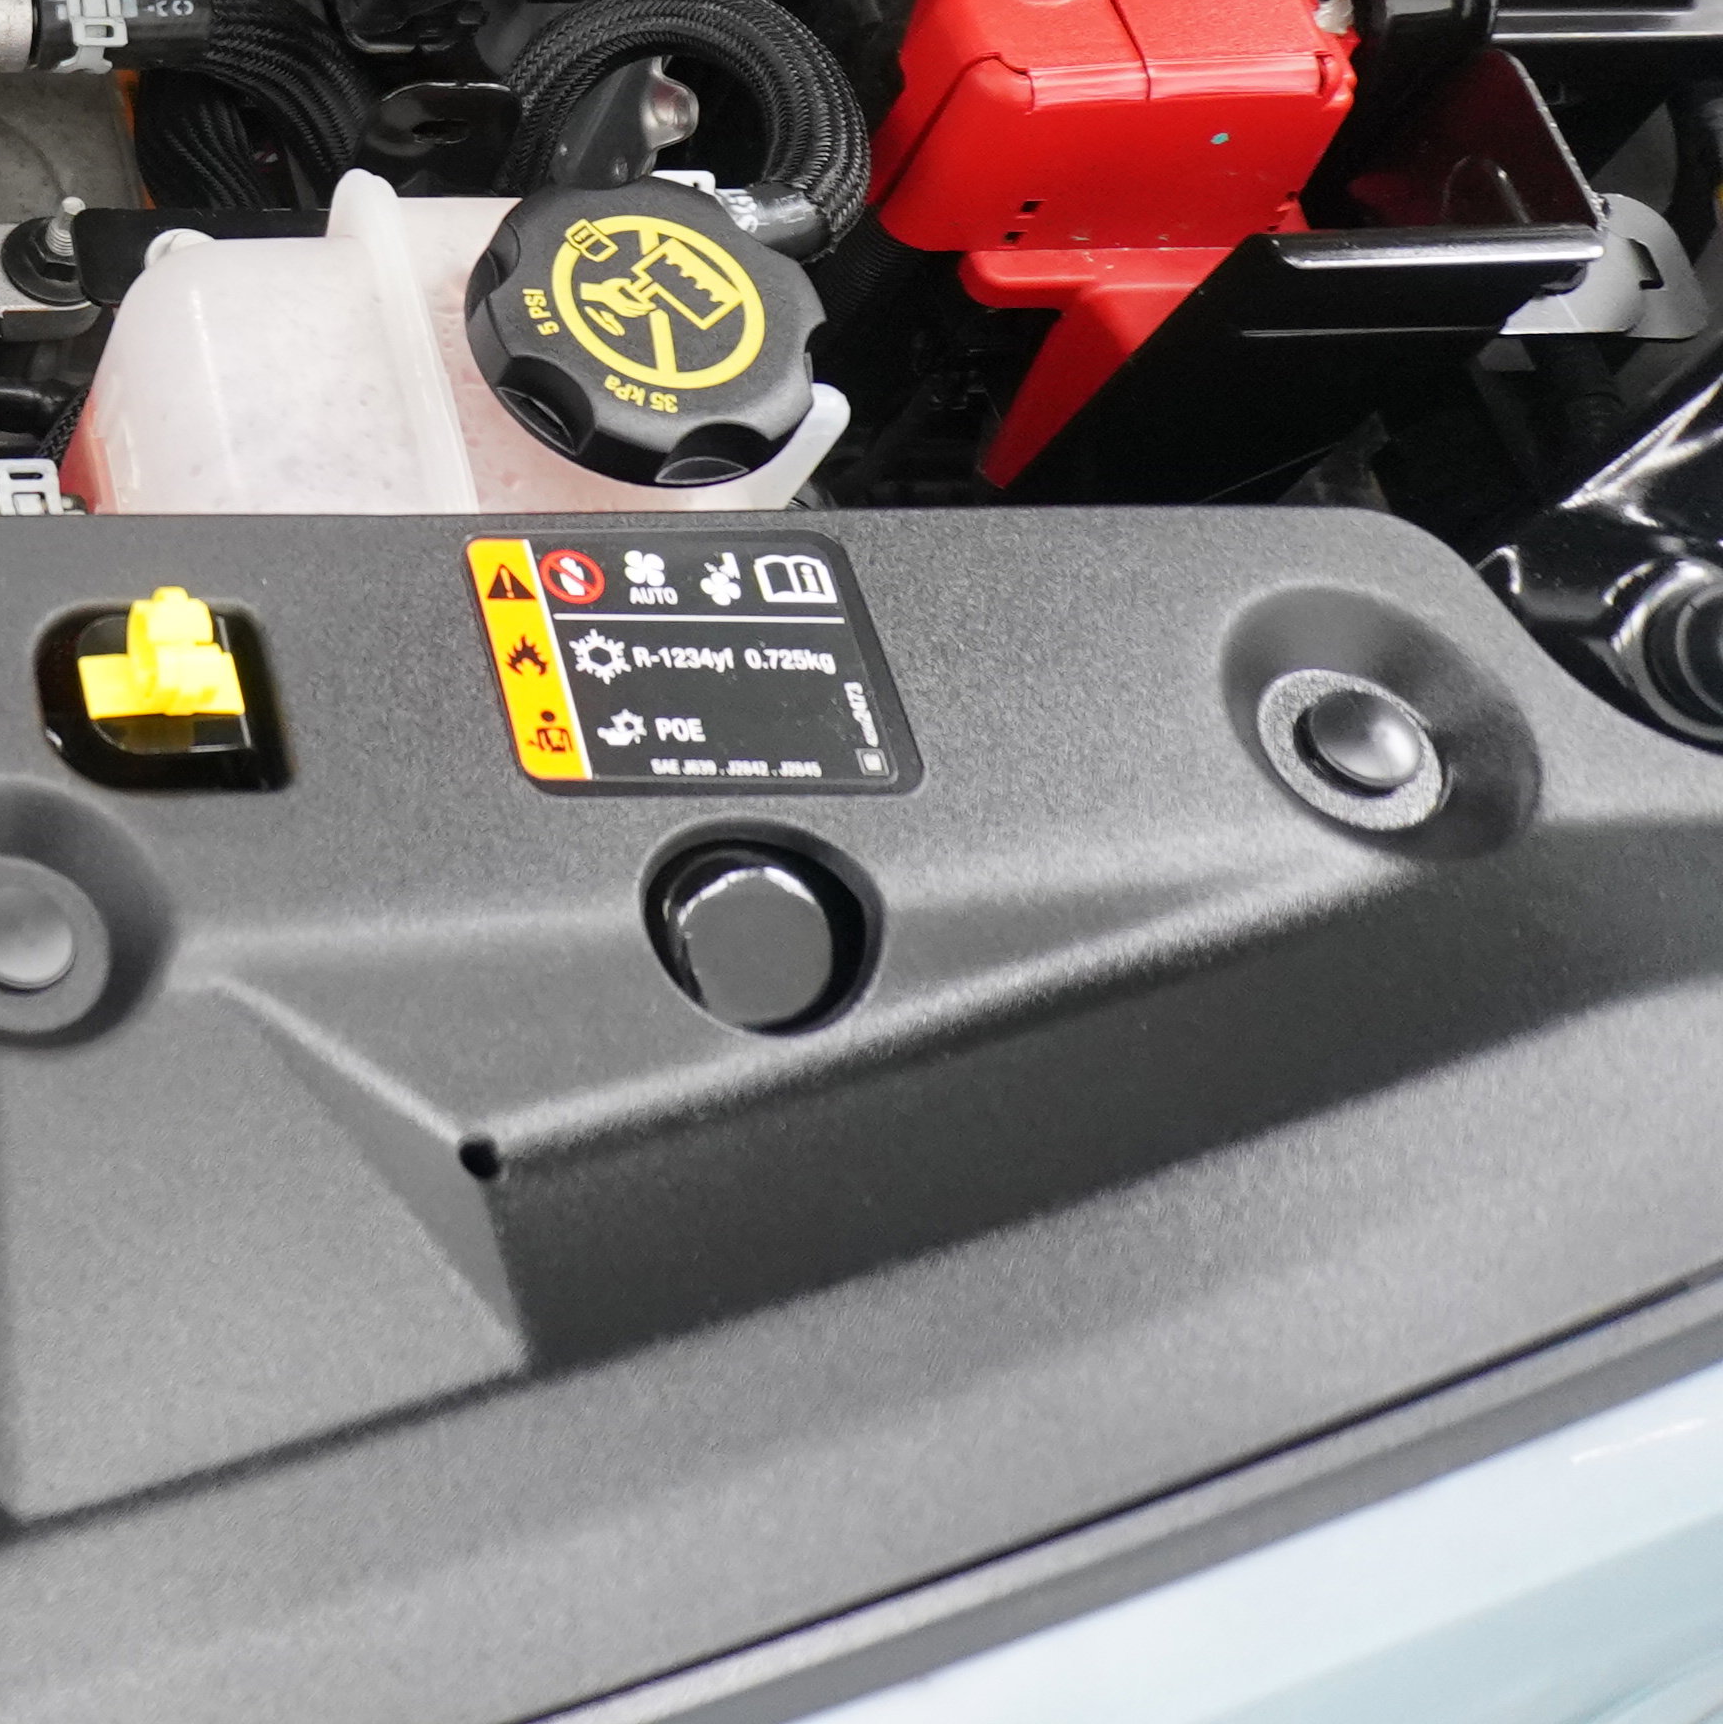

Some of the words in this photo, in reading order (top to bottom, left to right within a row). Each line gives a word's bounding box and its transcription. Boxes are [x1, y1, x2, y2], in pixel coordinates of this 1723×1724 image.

[521, 287, 546, 320] PSI
[536, 319, 561, 337] 5
[603, 374, 645, 407] kPa
[649, 392, 679, 414] 35
[630, 586, 678, 605] AUTO
[631, 645, 736, 672] R-1234yf
[745, 651, 837, 675] 0.725kg
[655, 717, 706, 743] POE
[650, 758, 681, 777] SAE
